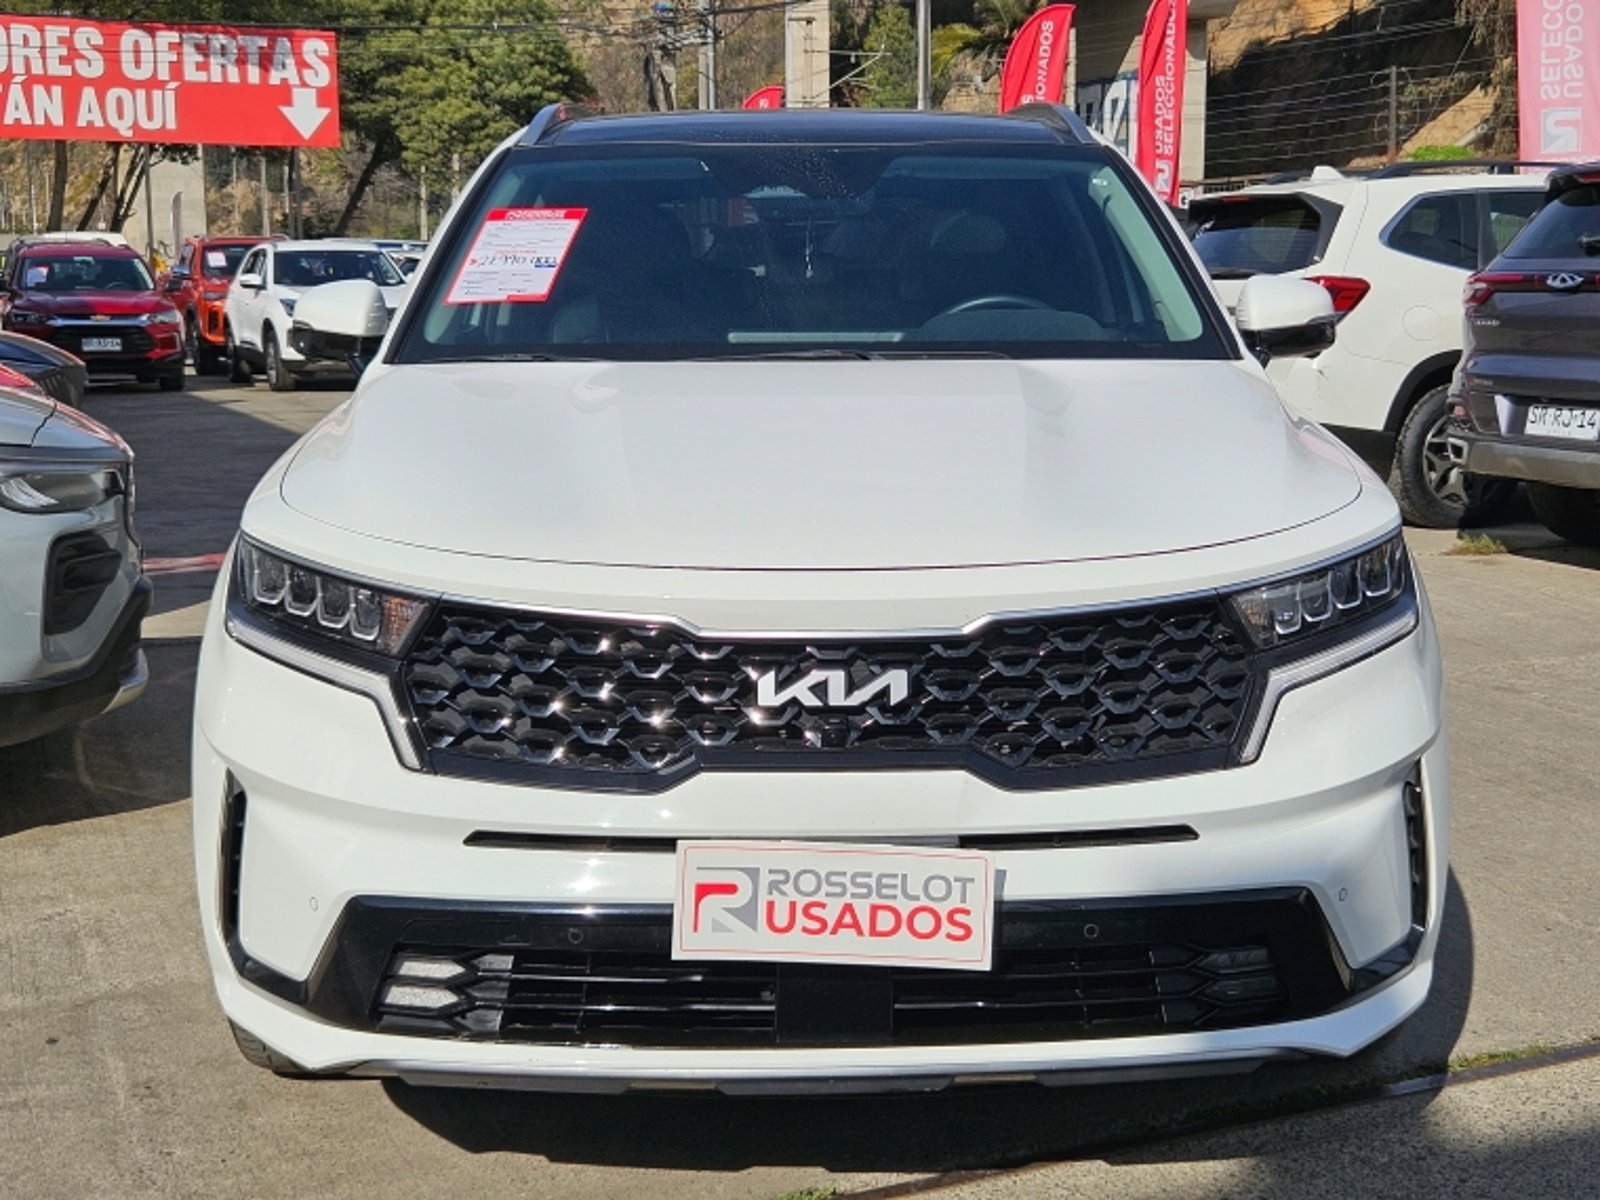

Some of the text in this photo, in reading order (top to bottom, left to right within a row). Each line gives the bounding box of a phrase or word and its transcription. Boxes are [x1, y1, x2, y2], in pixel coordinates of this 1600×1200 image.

[0, 23, 331, 88] RES OFERTAS
[0, 75, 181, 137] ÁN AQUÍ
[1155, 75, 1166, 153] USADOS
[758, 669, 908, 706] KIA
[768, 868, 975, 904] ROSSELOT
[766, 900, 973, 942] USADOS
